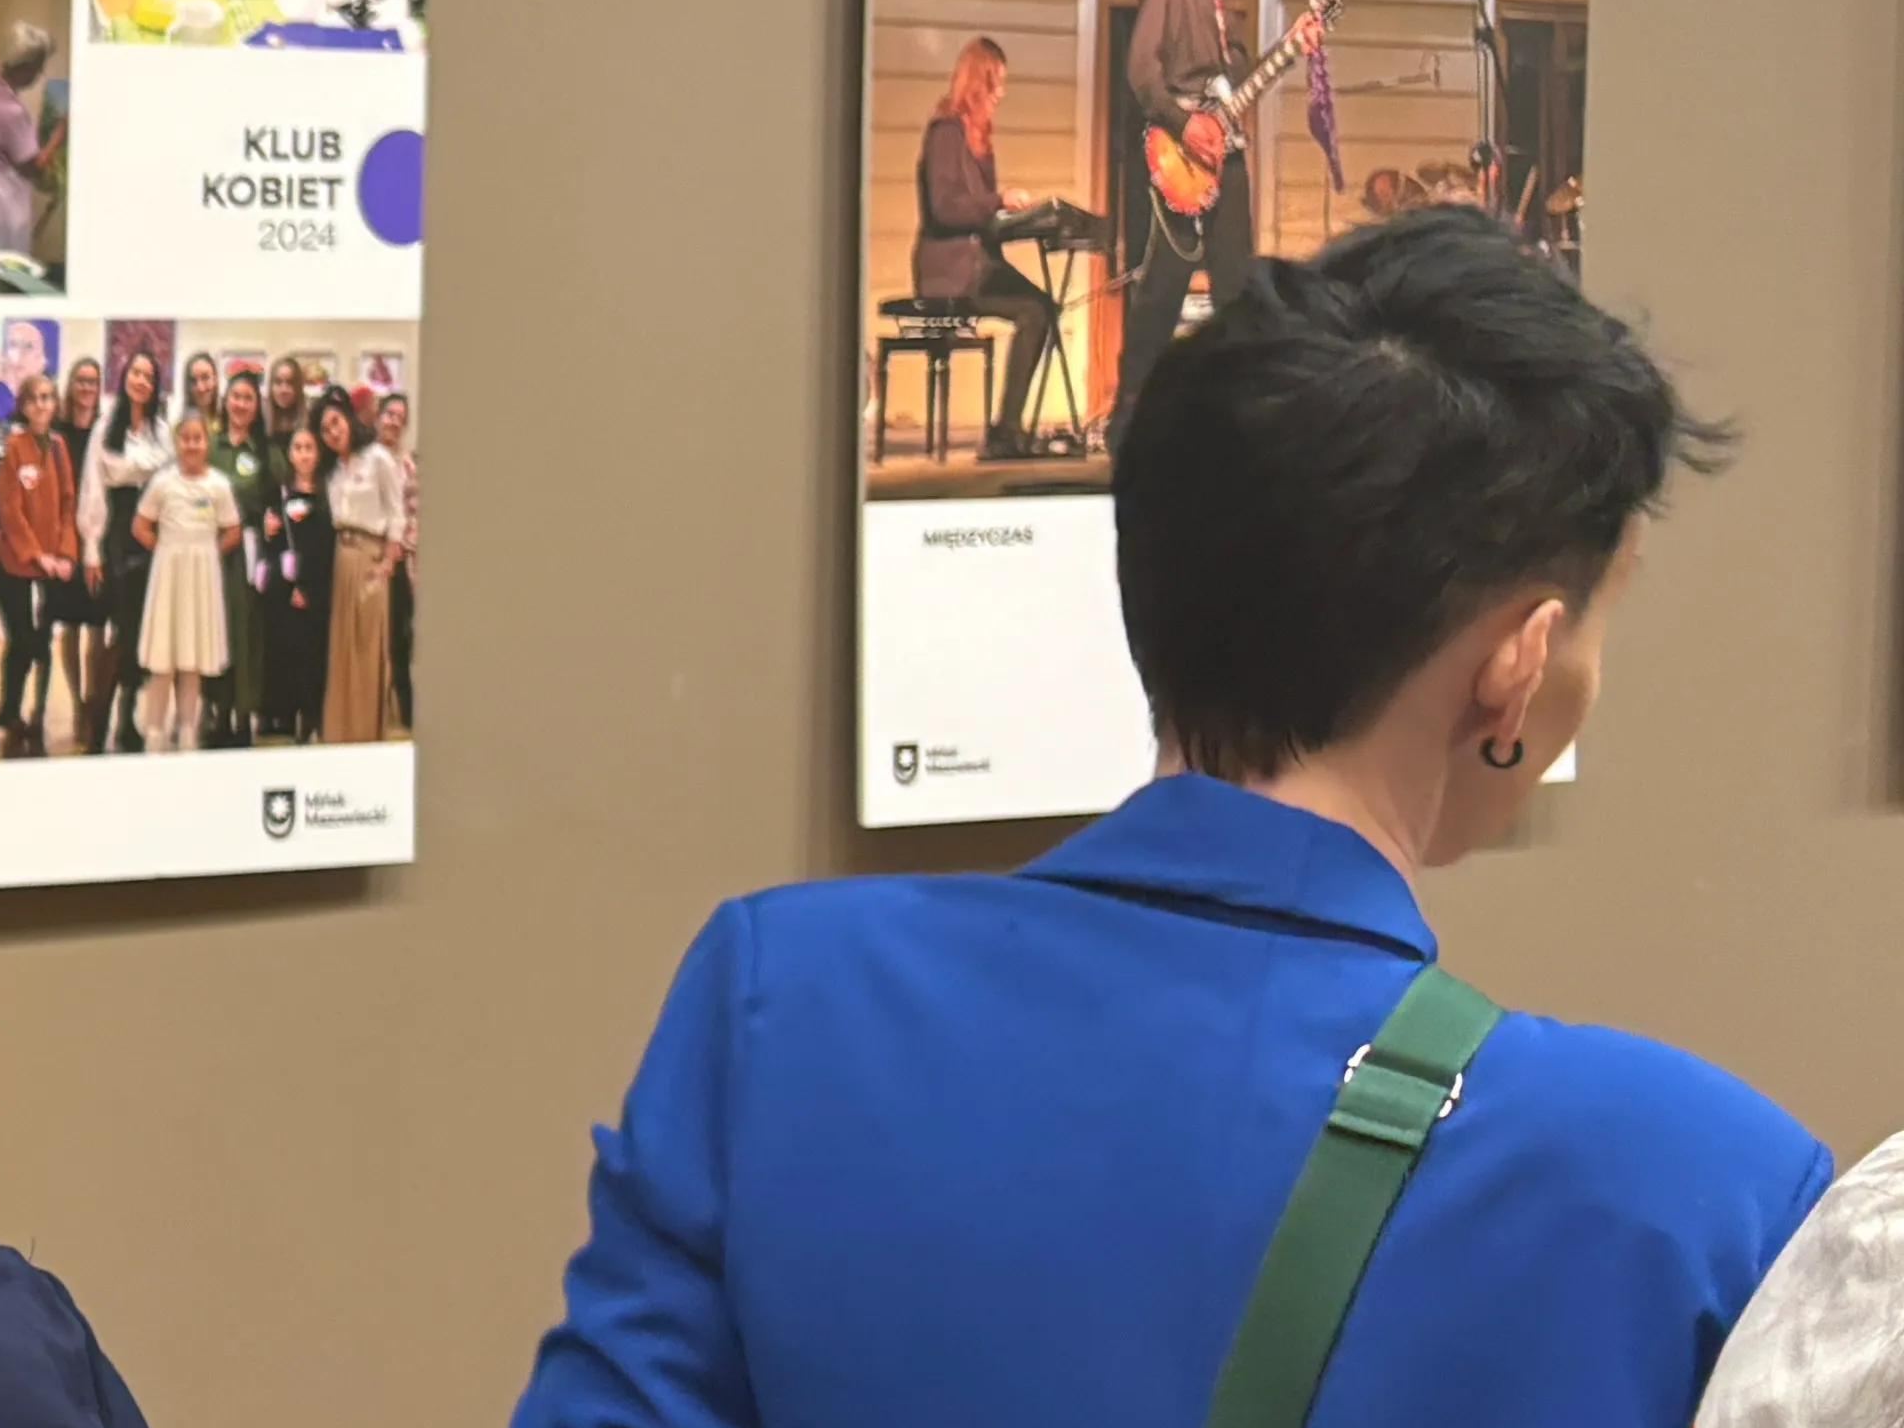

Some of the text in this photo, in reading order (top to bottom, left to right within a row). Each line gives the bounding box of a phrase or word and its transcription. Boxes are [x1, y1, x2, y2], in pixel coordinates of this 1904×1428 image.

[244, 127, 343, 162] KLUB
[202, 173, 345, 209] KOBIET
[258, 220, 337, 251] 2024
